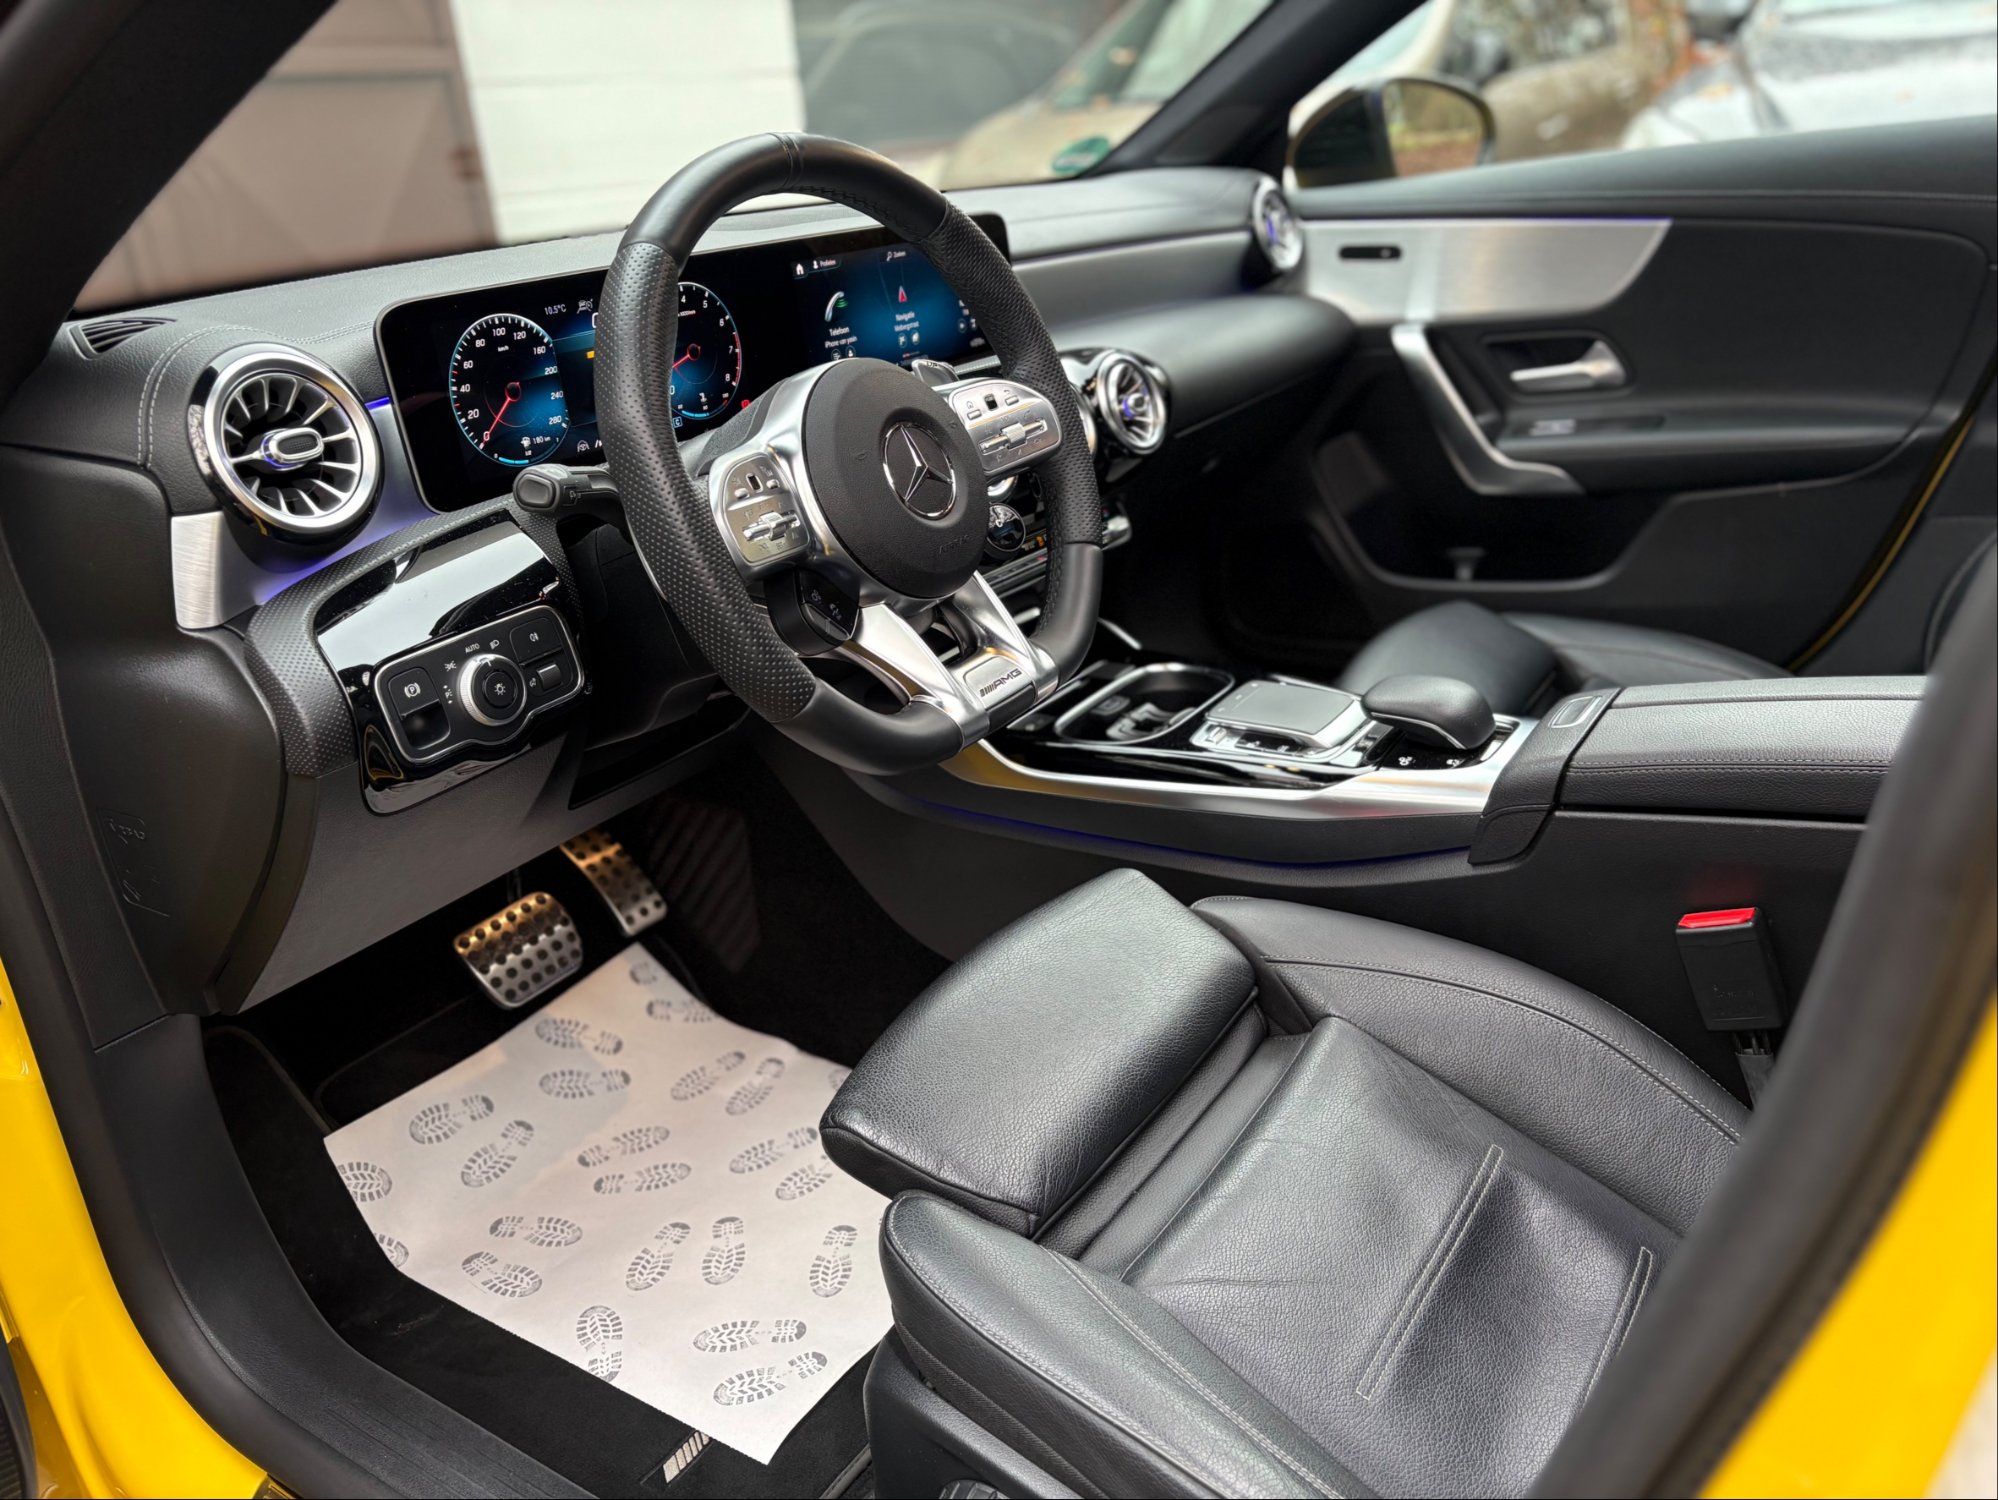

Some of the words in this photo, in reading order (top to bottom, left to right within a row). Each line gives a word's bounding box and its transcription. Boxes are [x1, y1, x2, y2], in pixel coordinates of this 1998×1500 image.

[681, 295, 686, 303] 4
[719, 318, 725, 327] 6
[492, 328, 506, 336] 100
[513, 331, 527, 340] 120
[475, 339, 486, 347] 80
[533, 346, 546, 355] 160
[729, 346, 734, 354] 7
[463, 360, 473, 369] 60
[545, 366, 558, 375] 200
[725, 373, 731, 381] 8
[460, 384, 471, 393] 40
[551, 391, 564, 400] 240
[468, 409, 479, 419] 20
[549, 416, 562, 425] 280
[483, 431, 490, 441] 0
[465, 643, 480, 653] AUTO
[993, 668, 1022, 689] AMG
